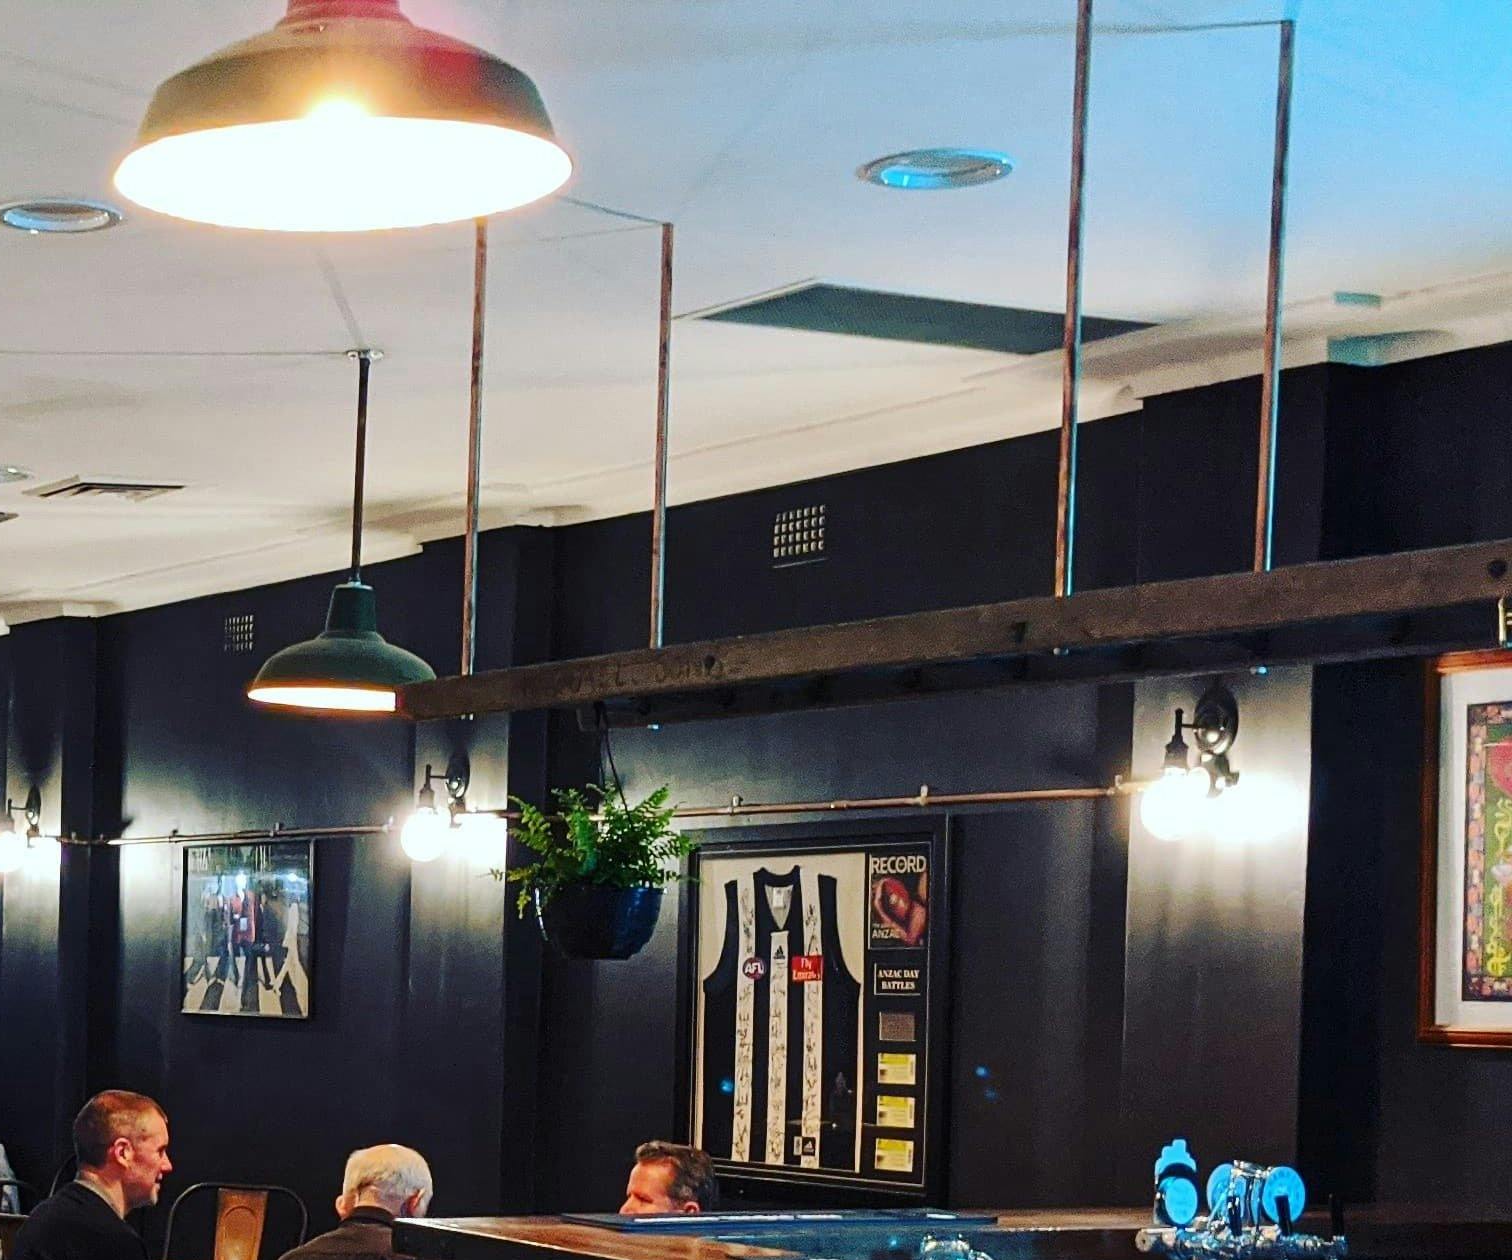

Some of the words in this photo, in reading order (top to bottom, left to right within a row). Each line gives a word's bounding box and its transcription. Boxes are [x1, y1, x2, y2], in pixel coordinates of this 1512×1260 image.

[871, 855, 927, 874] RECORD
[744, 961, 765, 975] AFL
[878, 969, 902, 978] ANZAC
[903, 969, 920, 979] DAY
[881, 980, 916, 990] BATTLES
